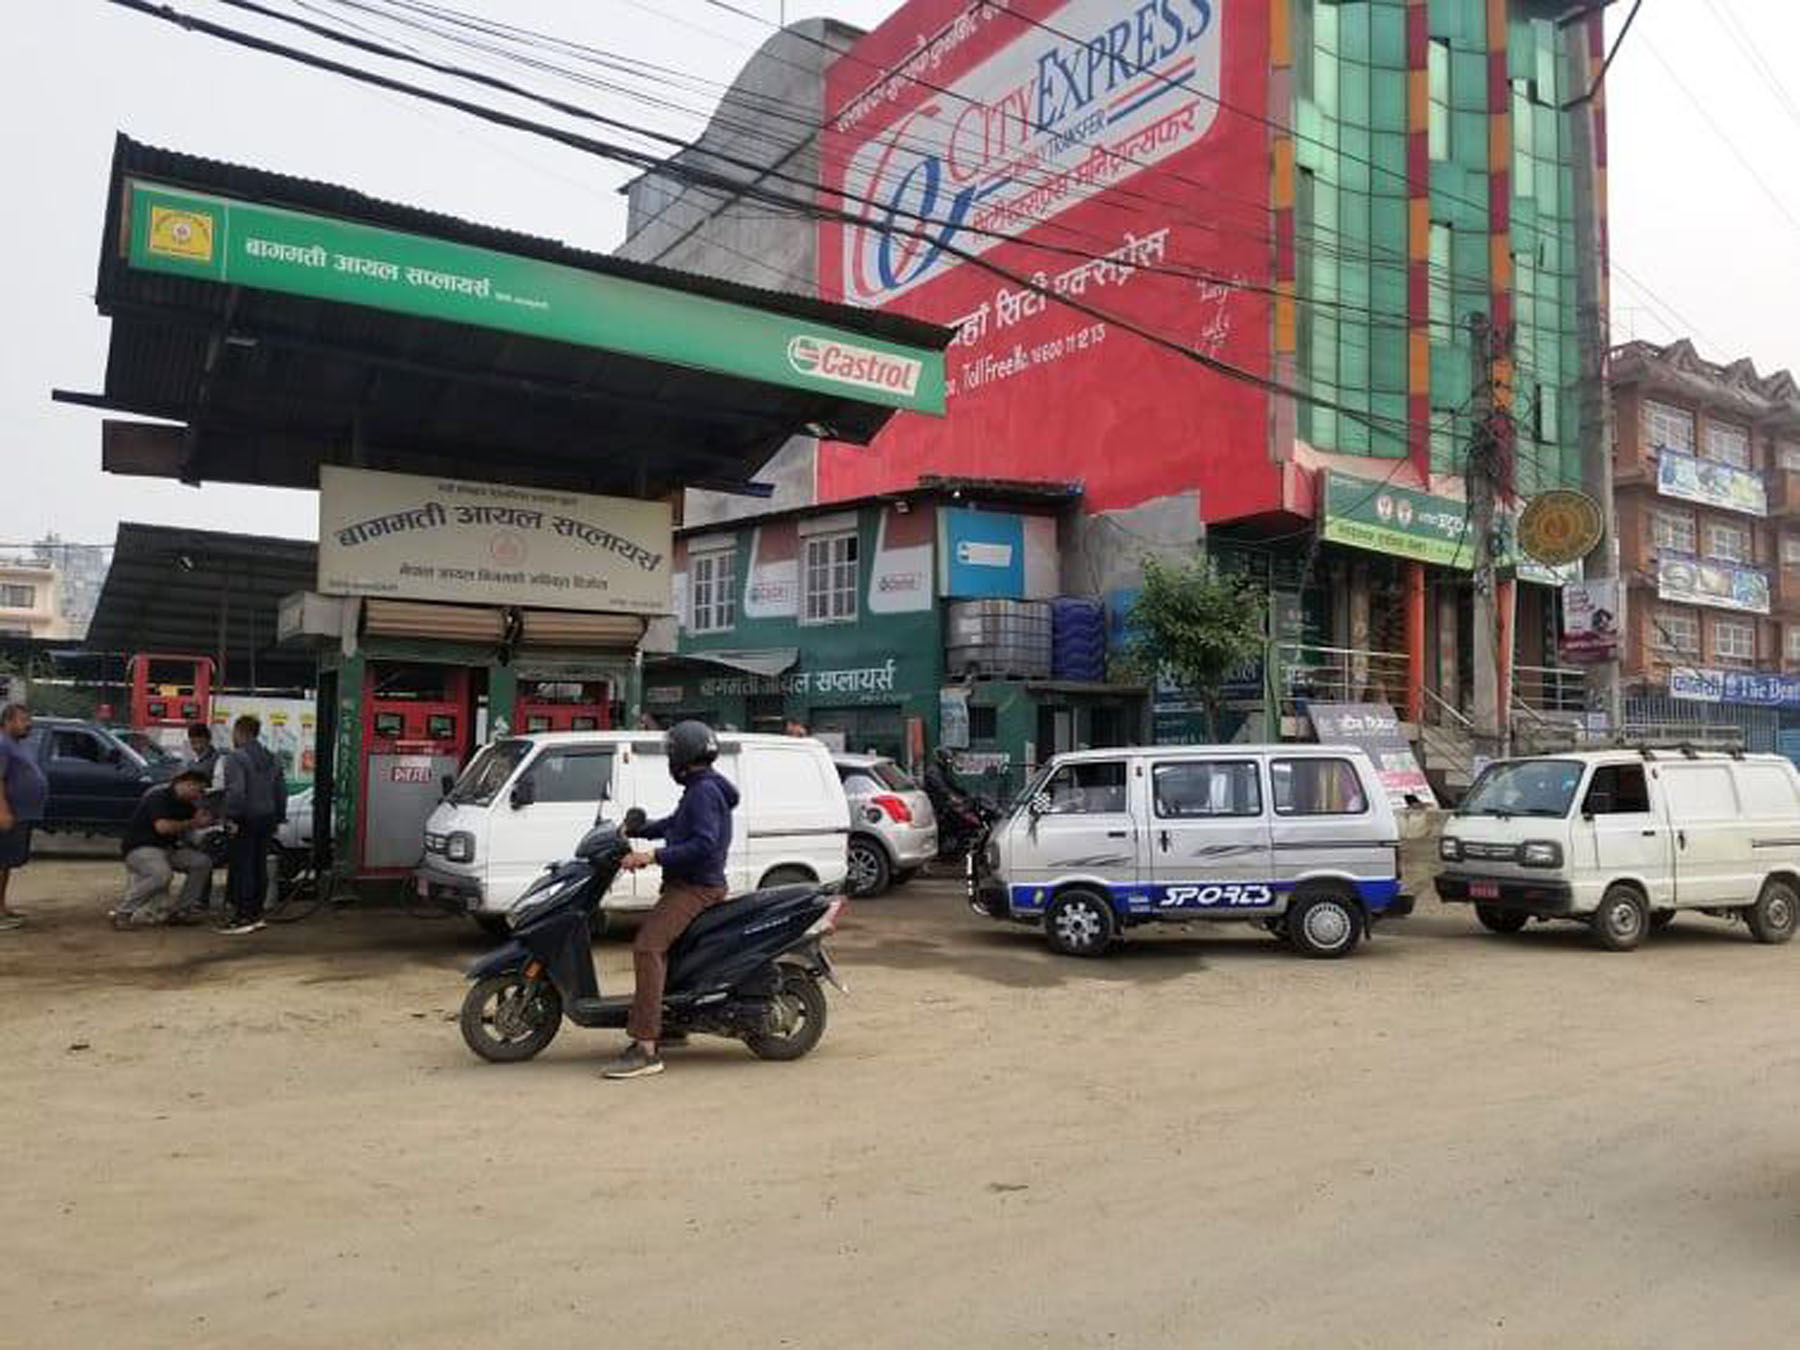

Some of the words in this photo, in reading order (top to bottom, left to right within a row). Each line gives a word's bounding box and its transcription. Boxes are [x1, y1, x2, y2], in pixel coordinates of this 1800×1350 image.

[245, 237, 326, 267] बागमती
[333, 253, 399, 281] आयल
[820, 343, 914, 391] Castrol
[333, 501, 447, 547] बागमती
[453, 504, 544, 530] आयल
[551, 515, 664, 572] सप्लायर्स
[815, 658, 897, 694] सप्लायर्स
